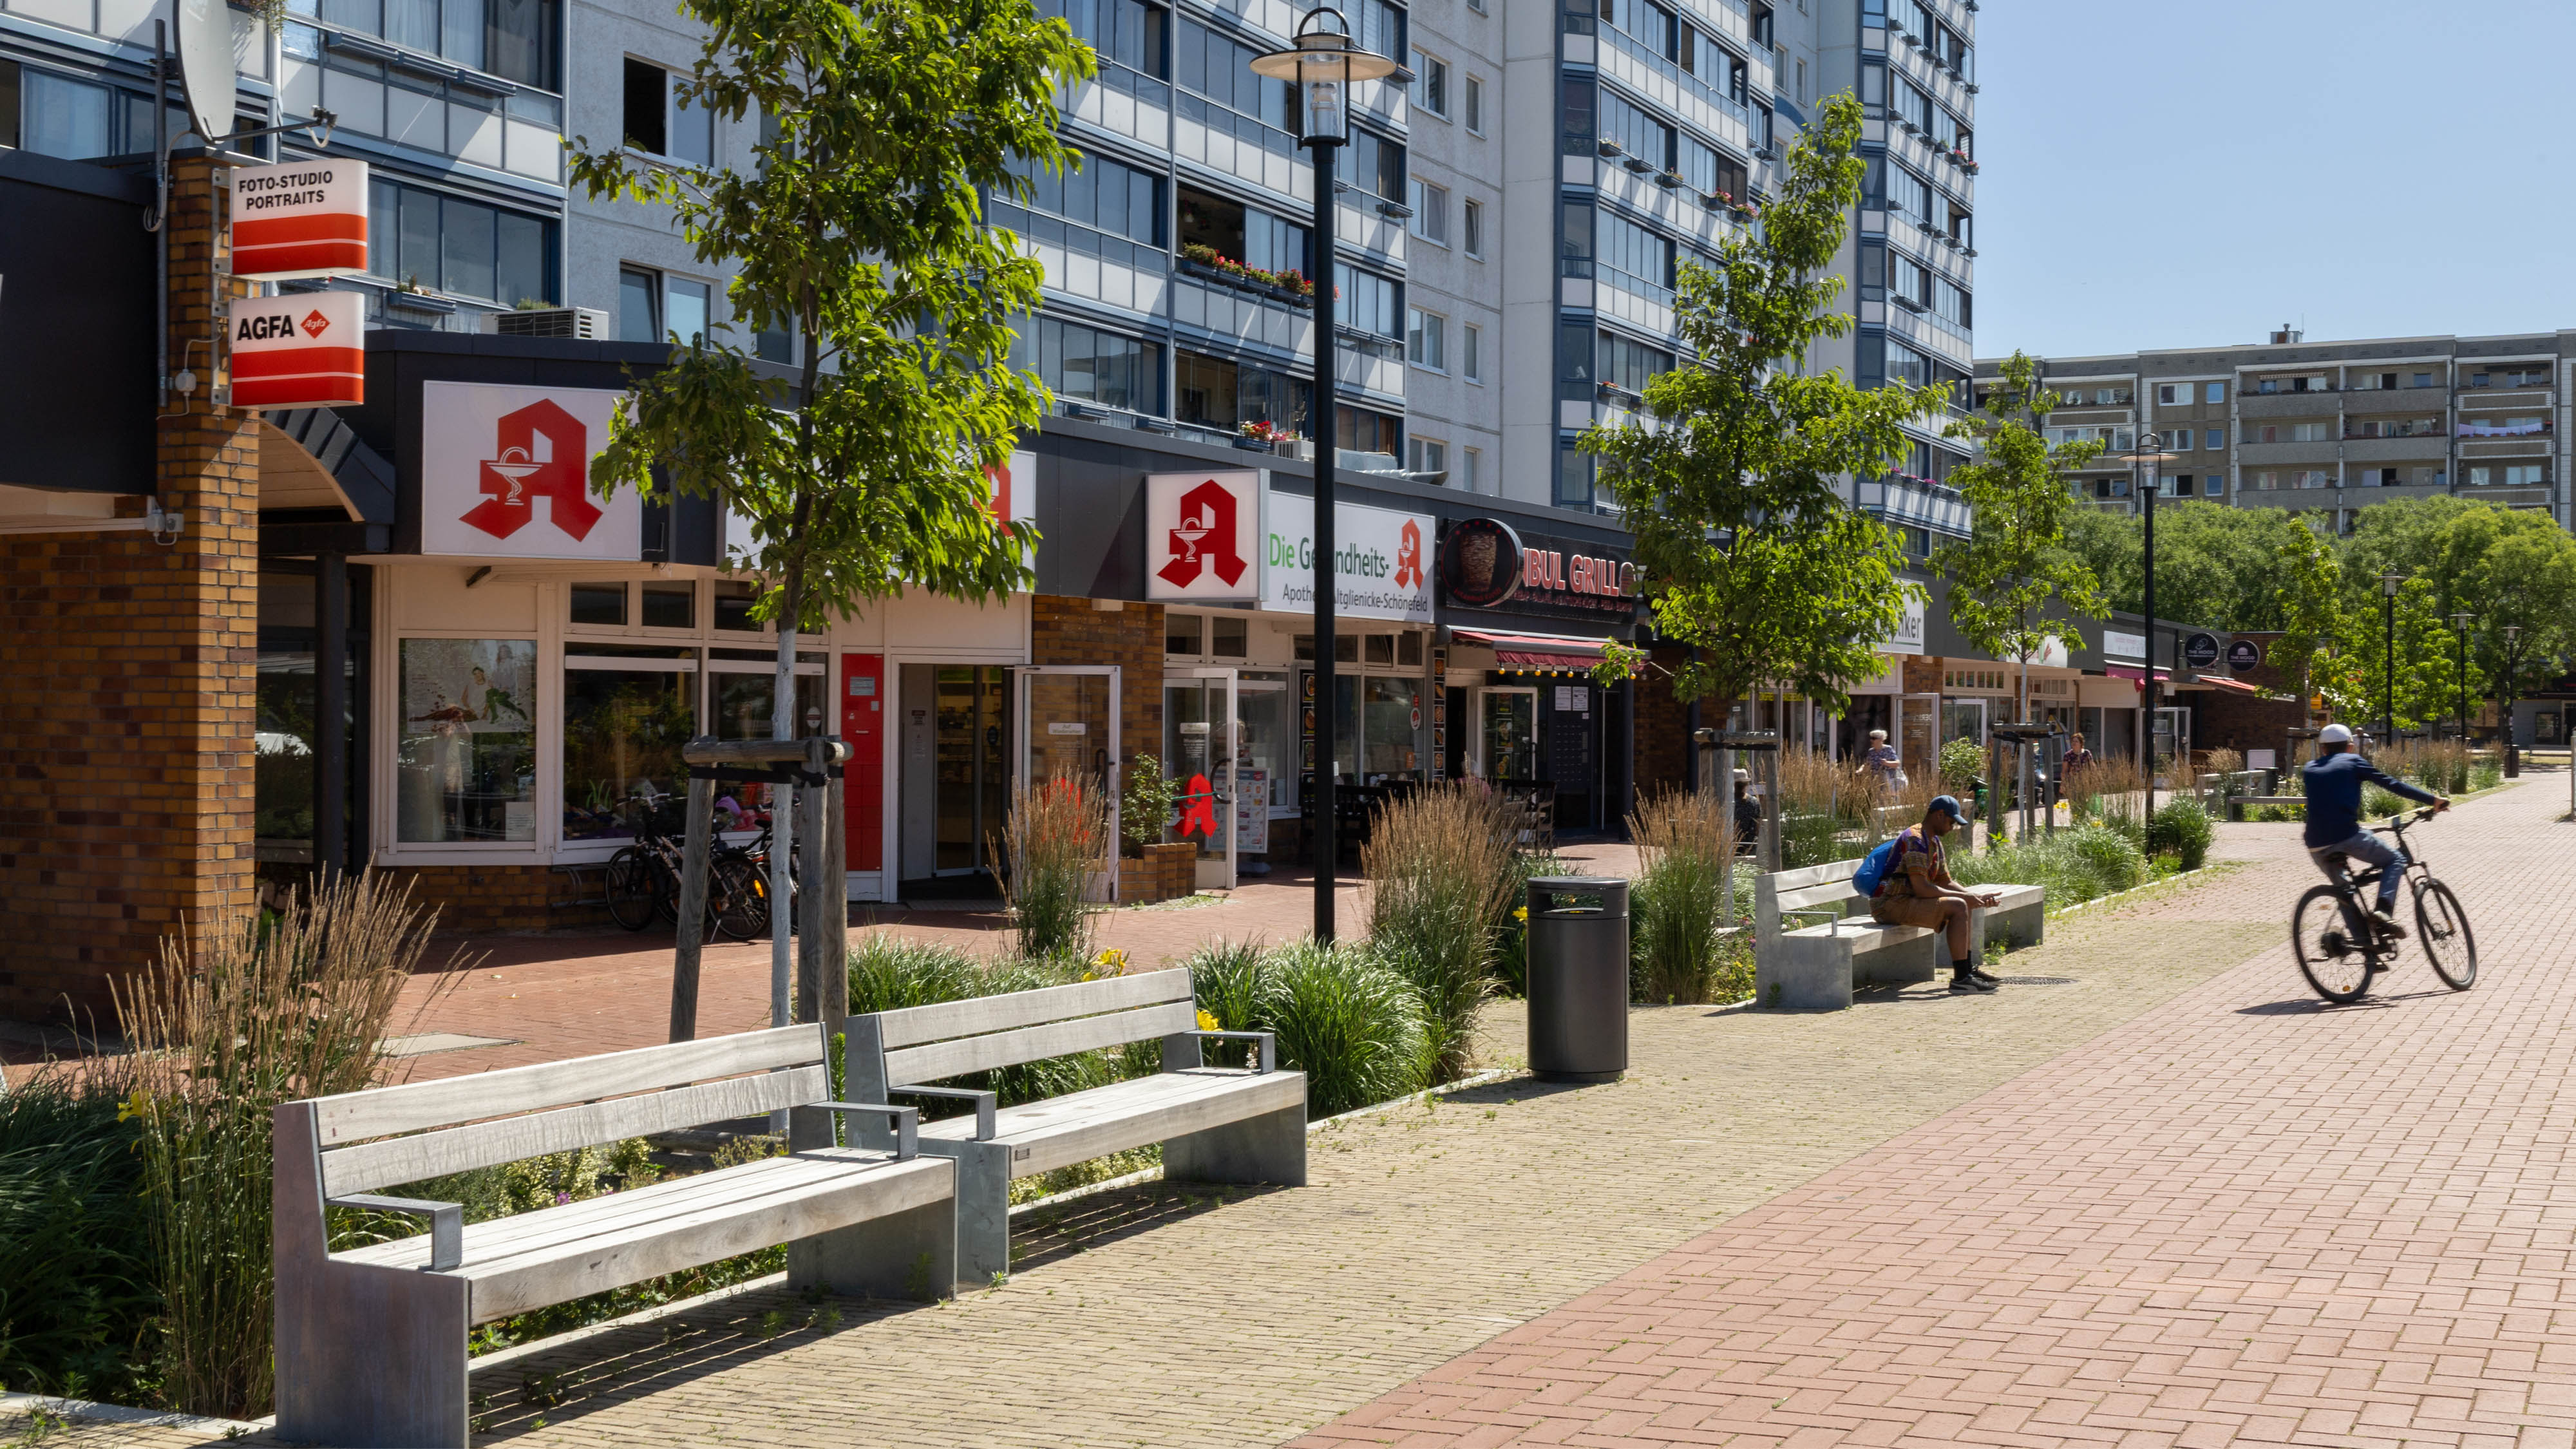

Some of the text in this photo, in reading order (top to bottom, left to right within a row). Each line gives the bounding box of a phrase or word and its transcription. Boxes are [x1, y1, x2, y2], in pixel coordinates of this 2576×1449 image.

[238, 170, 333, 193] FOTO-STUDIO
[246, 190, 325, 210] PORTRAITS
[237, 314, 295, 341] AGFA
[1269, 533, 1389, 578] Die Gndheits-
[1569, 554, 1619, 596] GRILL
[1334, 587, 1427, 612] ltglienicke-Schönefeld
